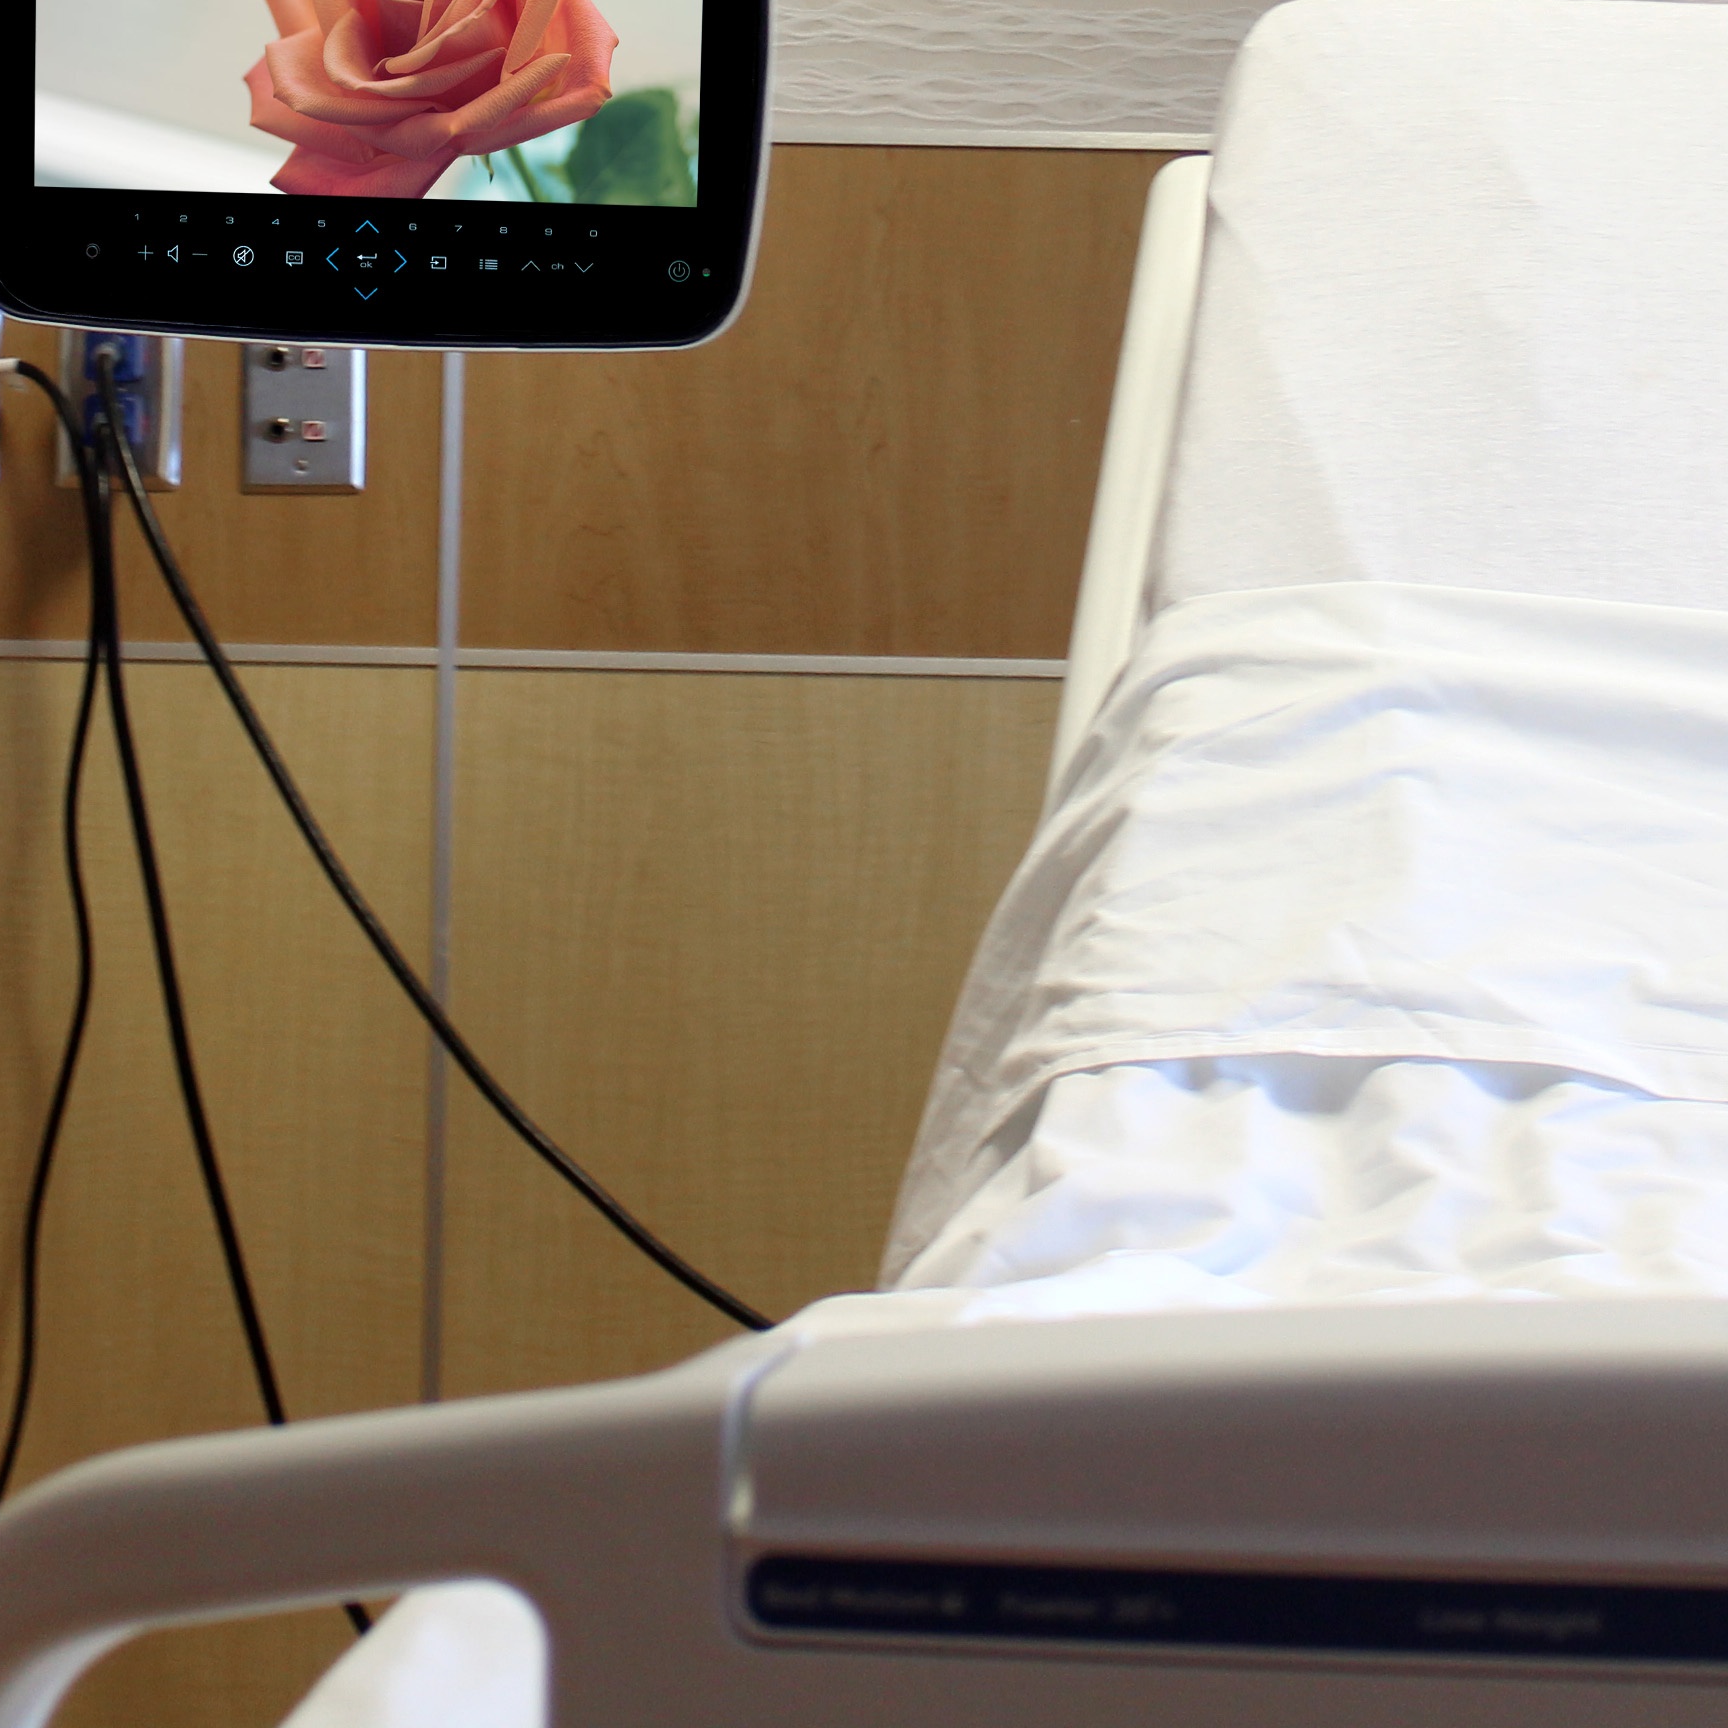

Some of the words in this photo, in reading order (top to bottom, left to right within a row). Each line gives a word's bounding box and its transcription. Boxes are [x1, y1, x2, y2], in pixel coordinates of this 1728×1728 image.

[134, 213, 140, 221] 1
[179, 214, 188, 223] 2
[225, 216, 234, 225] 3
[271, 218, 280, 226] 4
[317, 219, 326, 228] 5
[408, 223, 417, 231] 6
[454, 225, 462, 233] 7
[499, 226, 508, 234] 8
[544, 228, 553, 236] 9
[359, 260, 373, 269] ok
[551, 261, 564, 271] ch
